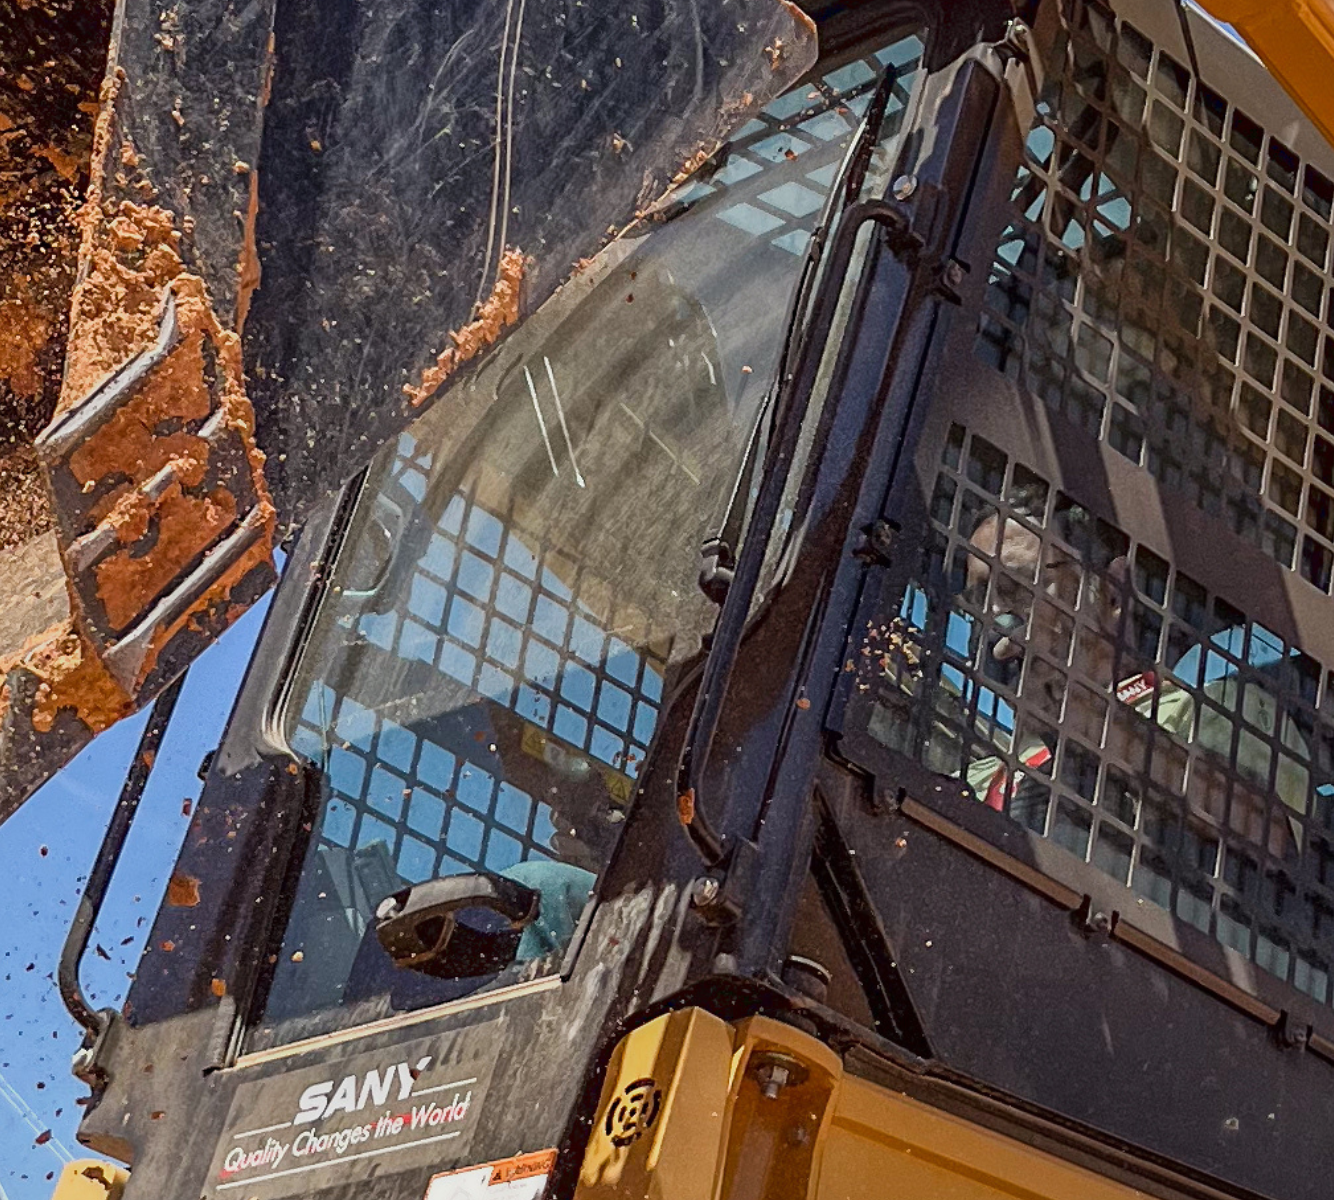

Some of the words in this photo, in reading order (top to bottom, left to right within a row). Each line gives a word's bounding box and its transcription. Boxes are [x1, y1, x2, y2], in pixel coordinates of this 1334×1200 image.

[293, 1055, 433, 1126] SANY
[223, 1138, 290, 1172] Quality
[292, 1127, 372, 1157] Changes
[374, 1110, 404, 1139] the
[410, 1090, 472, 1131] World
